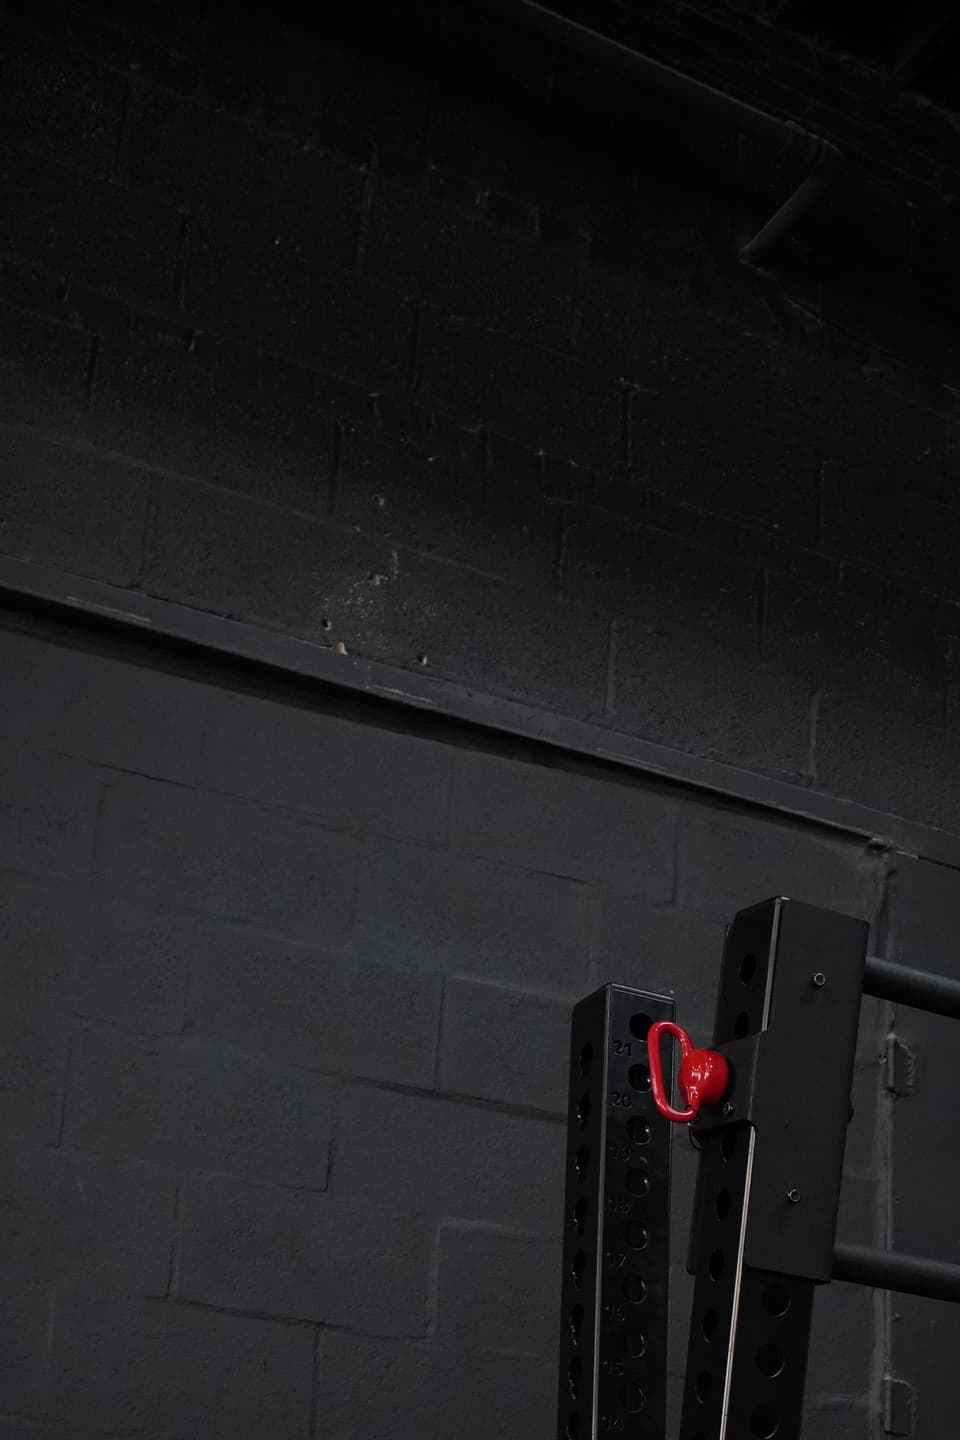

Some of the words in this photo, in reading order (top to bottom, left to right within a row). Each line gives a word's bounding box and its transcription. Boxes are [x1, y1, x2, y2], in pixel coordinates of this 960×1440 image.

[613, 1040, 632, 1057] 21
[611, 1091, 632, 1109] 20
[607, 1250, 627, 1267] 17
